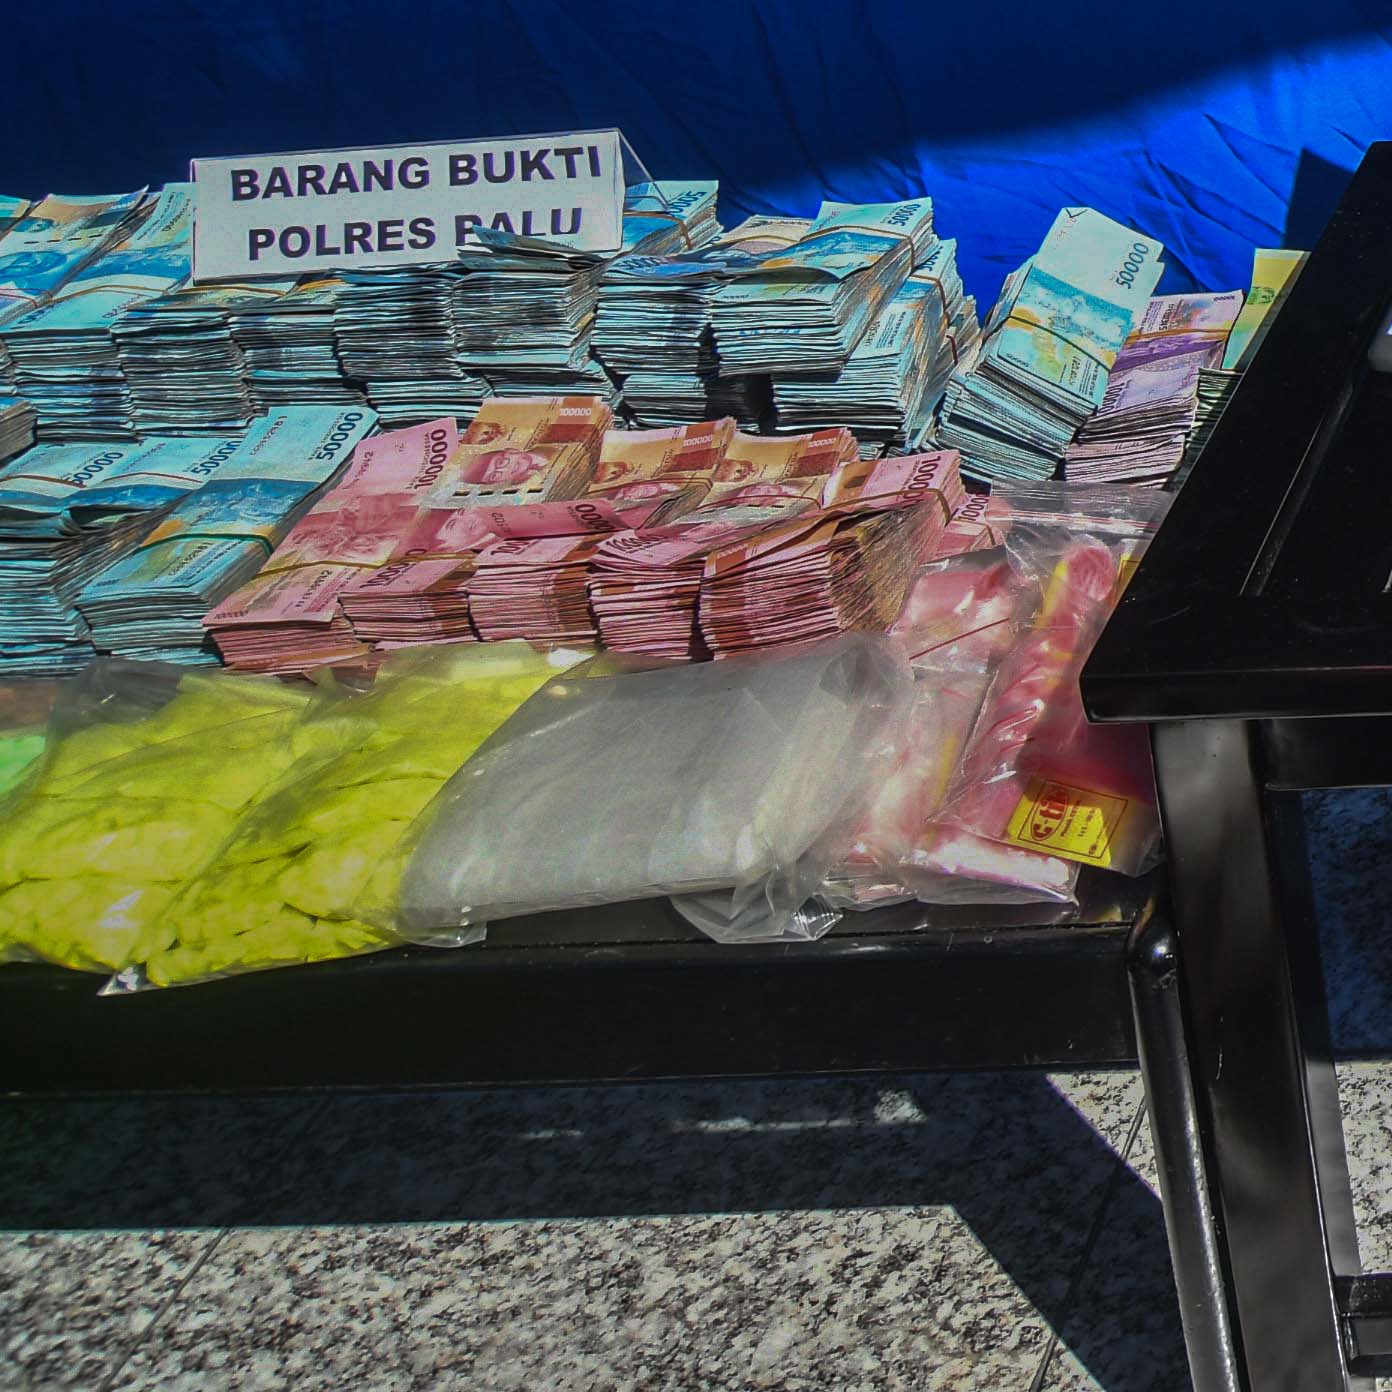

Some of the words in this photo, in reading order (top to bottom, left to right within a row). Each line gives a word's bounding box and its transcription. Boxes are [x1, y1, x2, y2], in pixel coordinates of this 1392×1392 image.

[230, 157, 431, 202] BARANG
[448, 145, 602, 187] BUKTI
[248, 217, 437, 262] POLRES
[1115, 242, 1150, 290] 50000
[315, 411, 364, 461] 50000
[413, 428, 449, 491] 100000
